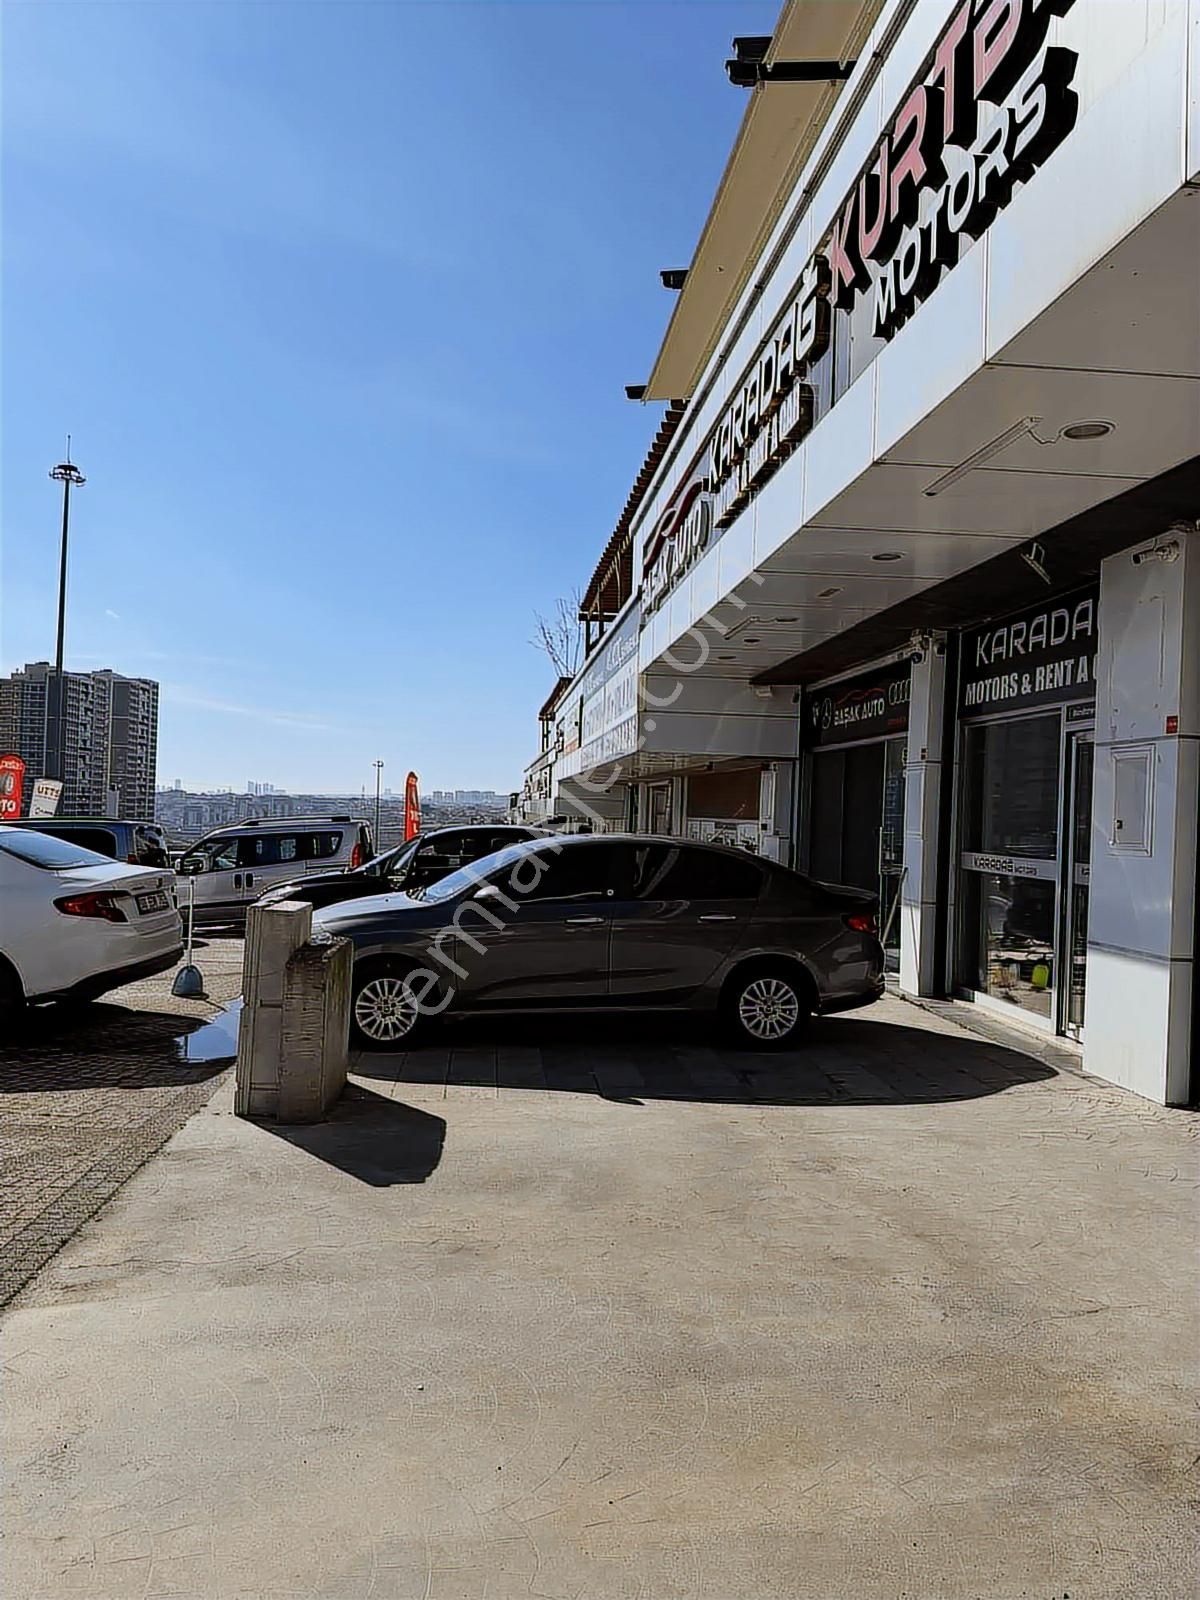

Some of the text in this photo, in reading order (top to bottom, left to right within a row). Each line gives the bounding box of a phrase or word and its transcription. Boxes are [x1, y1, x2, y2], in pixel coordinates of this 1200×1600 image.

[826, 0, 1042, 305] KURTB
[872, 48, 1047, 339] MOTORS
[976, 599, 1099, 667] KARADA
[861, 698, 885, 719] AUTO
[965, 672, 1018, 706] MOTORS
[1021, 673, 1032, 695] &
[1035, 658, 1075, 692] RENT
[1077, 655, 1089, 684] A
